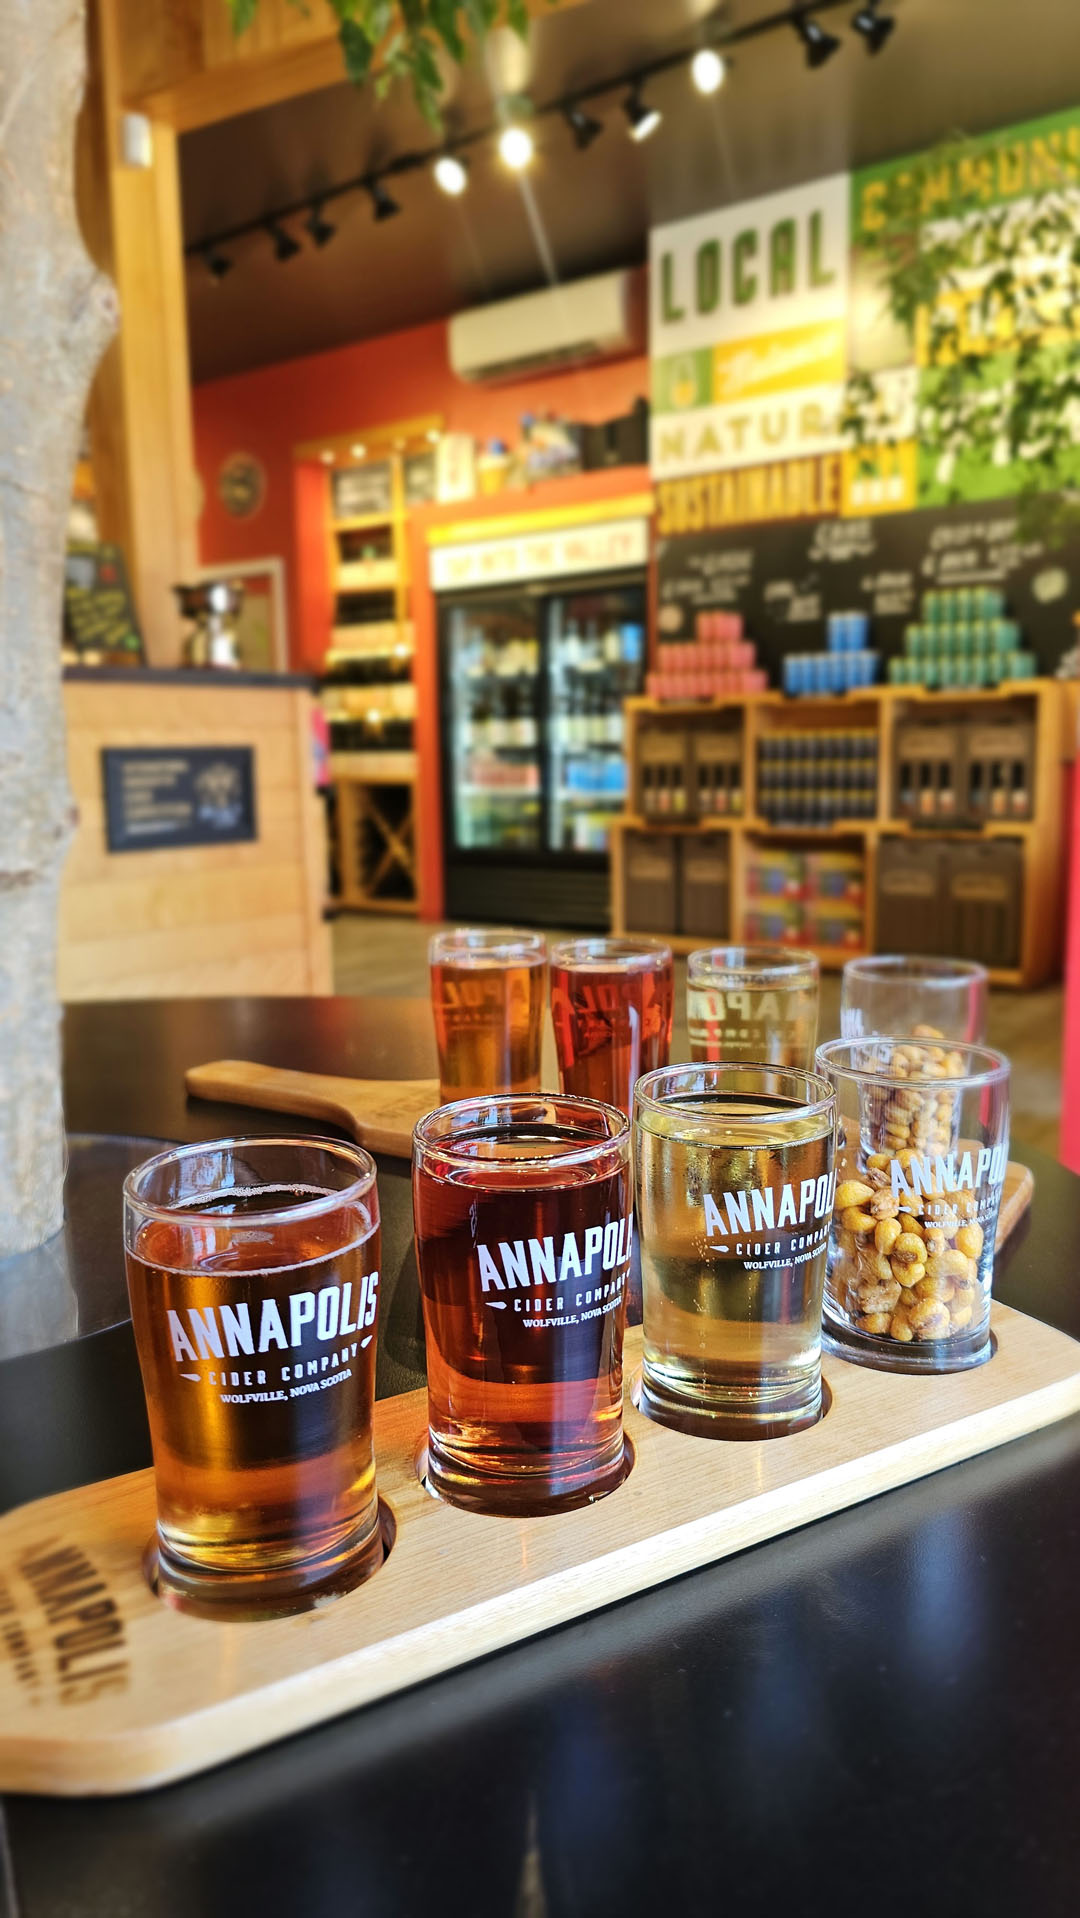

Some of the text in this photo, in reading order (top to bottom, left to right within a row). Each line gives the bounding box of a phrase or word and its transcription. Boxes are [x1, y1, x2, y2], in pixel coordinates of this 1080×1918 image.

[661, 209, 835, 324] LOCAL
[736, 1242, 781, 1256] CIDER
[794, 1252, 812, 1265] NOVA
[514, 1274, 626, 1312] CIDER COMPANY
[167, 1271, 379, 1362] ANNAPOLIS
[523, 1315, 579, 1328] WOLFVILLE,
[581, 1307, 602, 1322] NOVA
[209, 1342, 358, 1387] CIDER COMPANY
[220, 1368, 353, 1404] WOLFVILLE, NOVA SCOTIA
[14, 1533, 130, 1706] ANNAPOLIS
